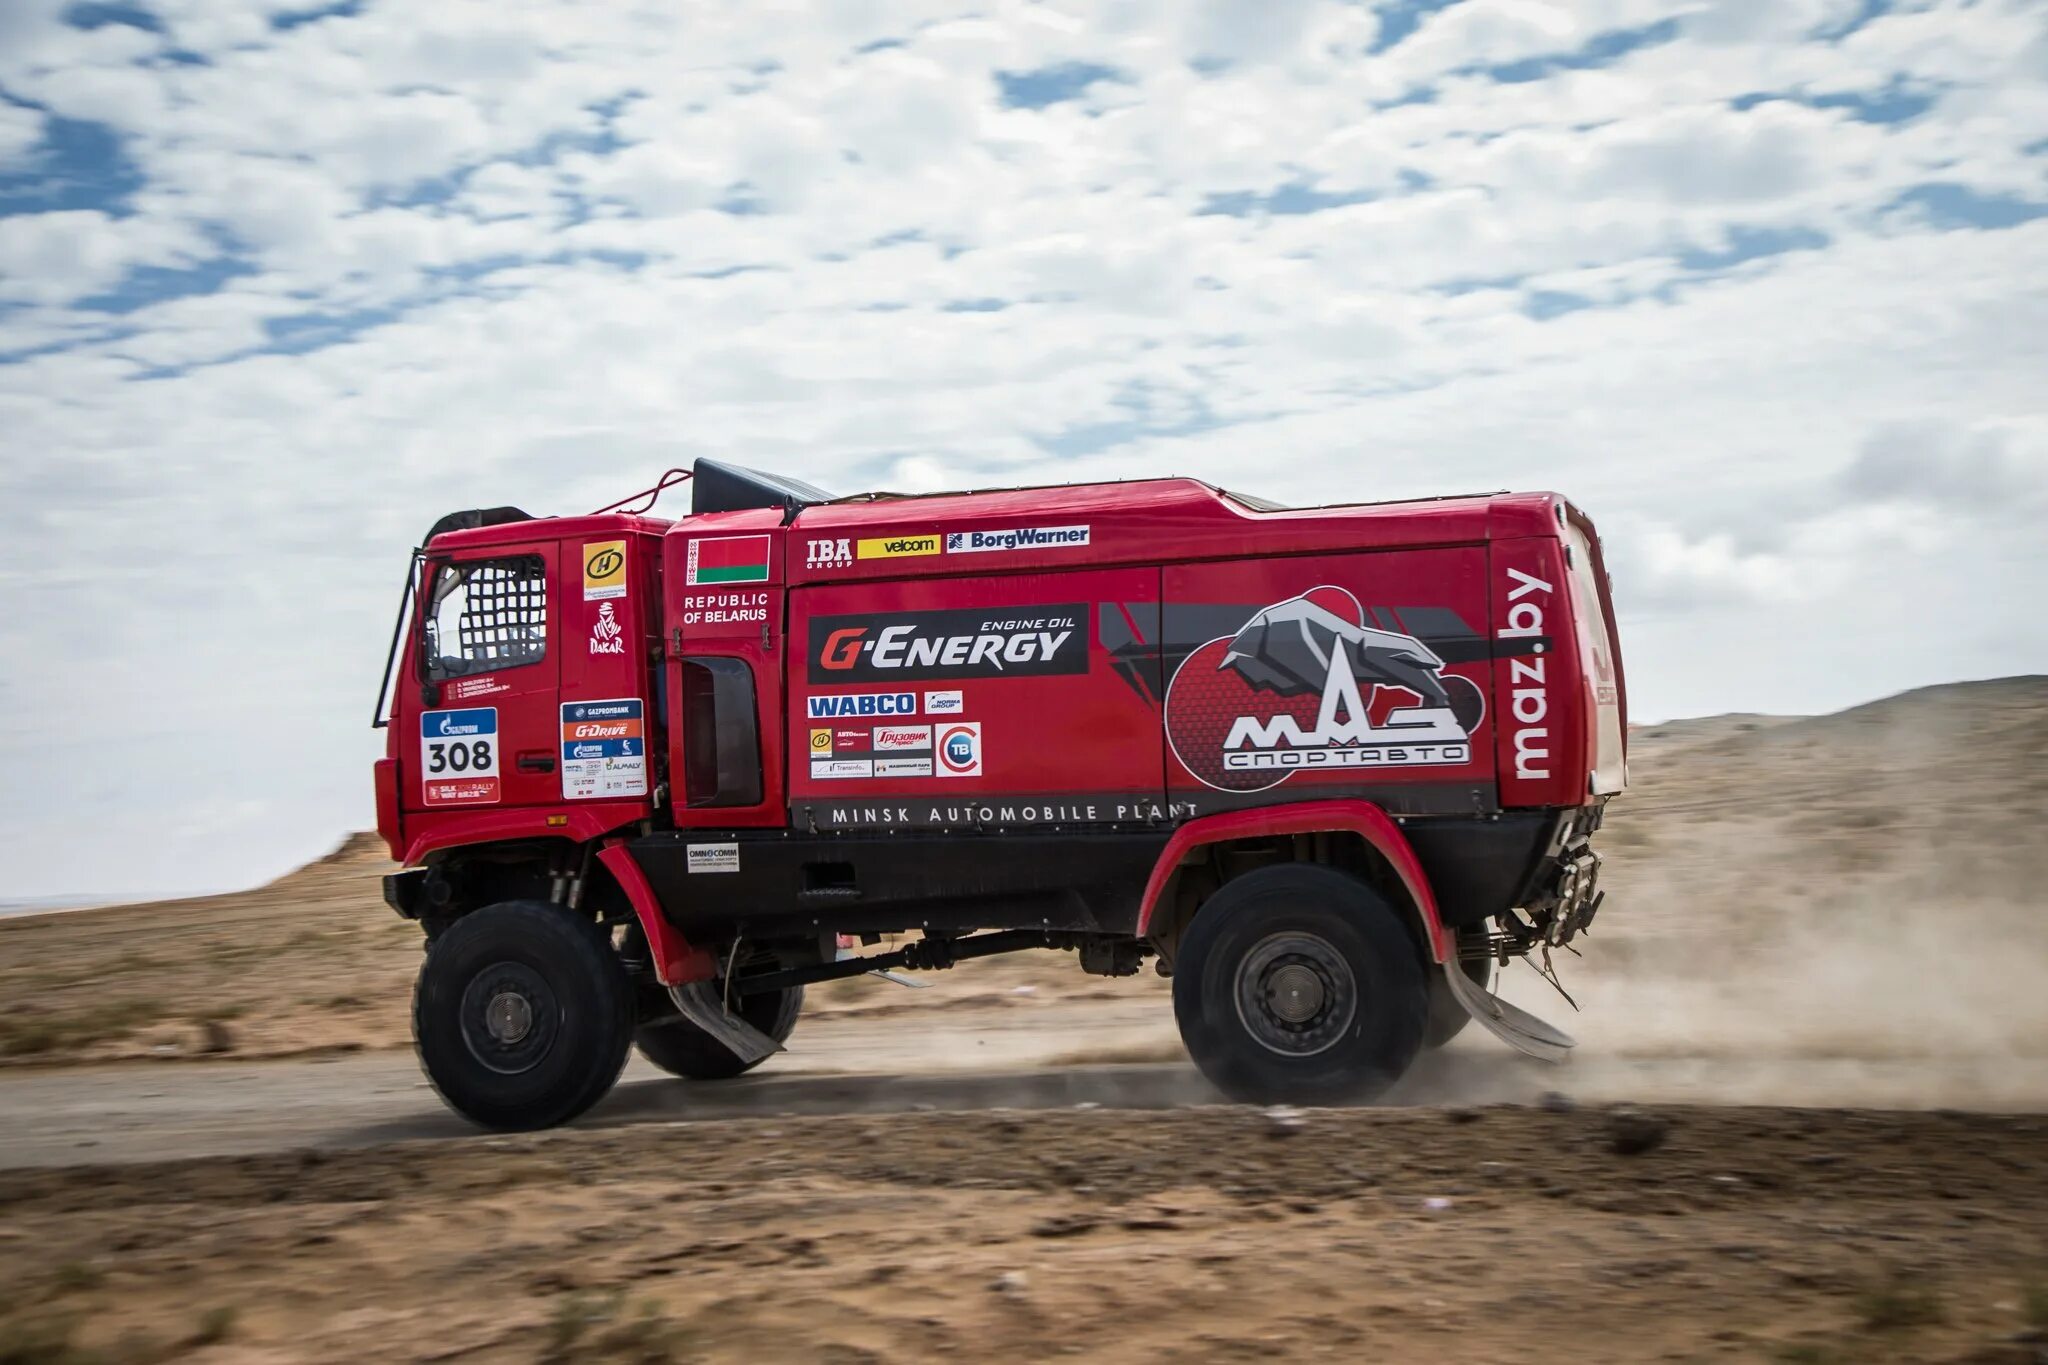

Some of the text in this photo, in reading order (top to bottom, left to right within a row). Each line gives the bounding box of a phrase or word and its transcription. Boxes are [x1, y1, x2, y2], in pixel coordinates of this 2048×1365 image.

[885, 537, 934, 553] velcom
[970, 528, 1089, 549] BorgWarner
[807, 539, 852, 563] IBA
[806, 560, 853, 570] GROUP
[684, 593, 768, 609] REPUBLIC
[683, 608, 767, 624] OF BELARUS
[980, 617, 1076, 632] ENGINE OIL
[1497, 567, 1554, 780] maz.by
[587, 706, 630, 716] GAZPROMBANK
[809, 693, 915, 717] WABCO
[428, 740, 492, 774] 308
[1228, 746, 1464, 767] СПОРТАВТО
[612, 762, 641, 770] ALMALY
[471, 782, 495, 790] RALLY
[832, 803, 1198, 823] MINSK AUTOMOBILE PLANT
